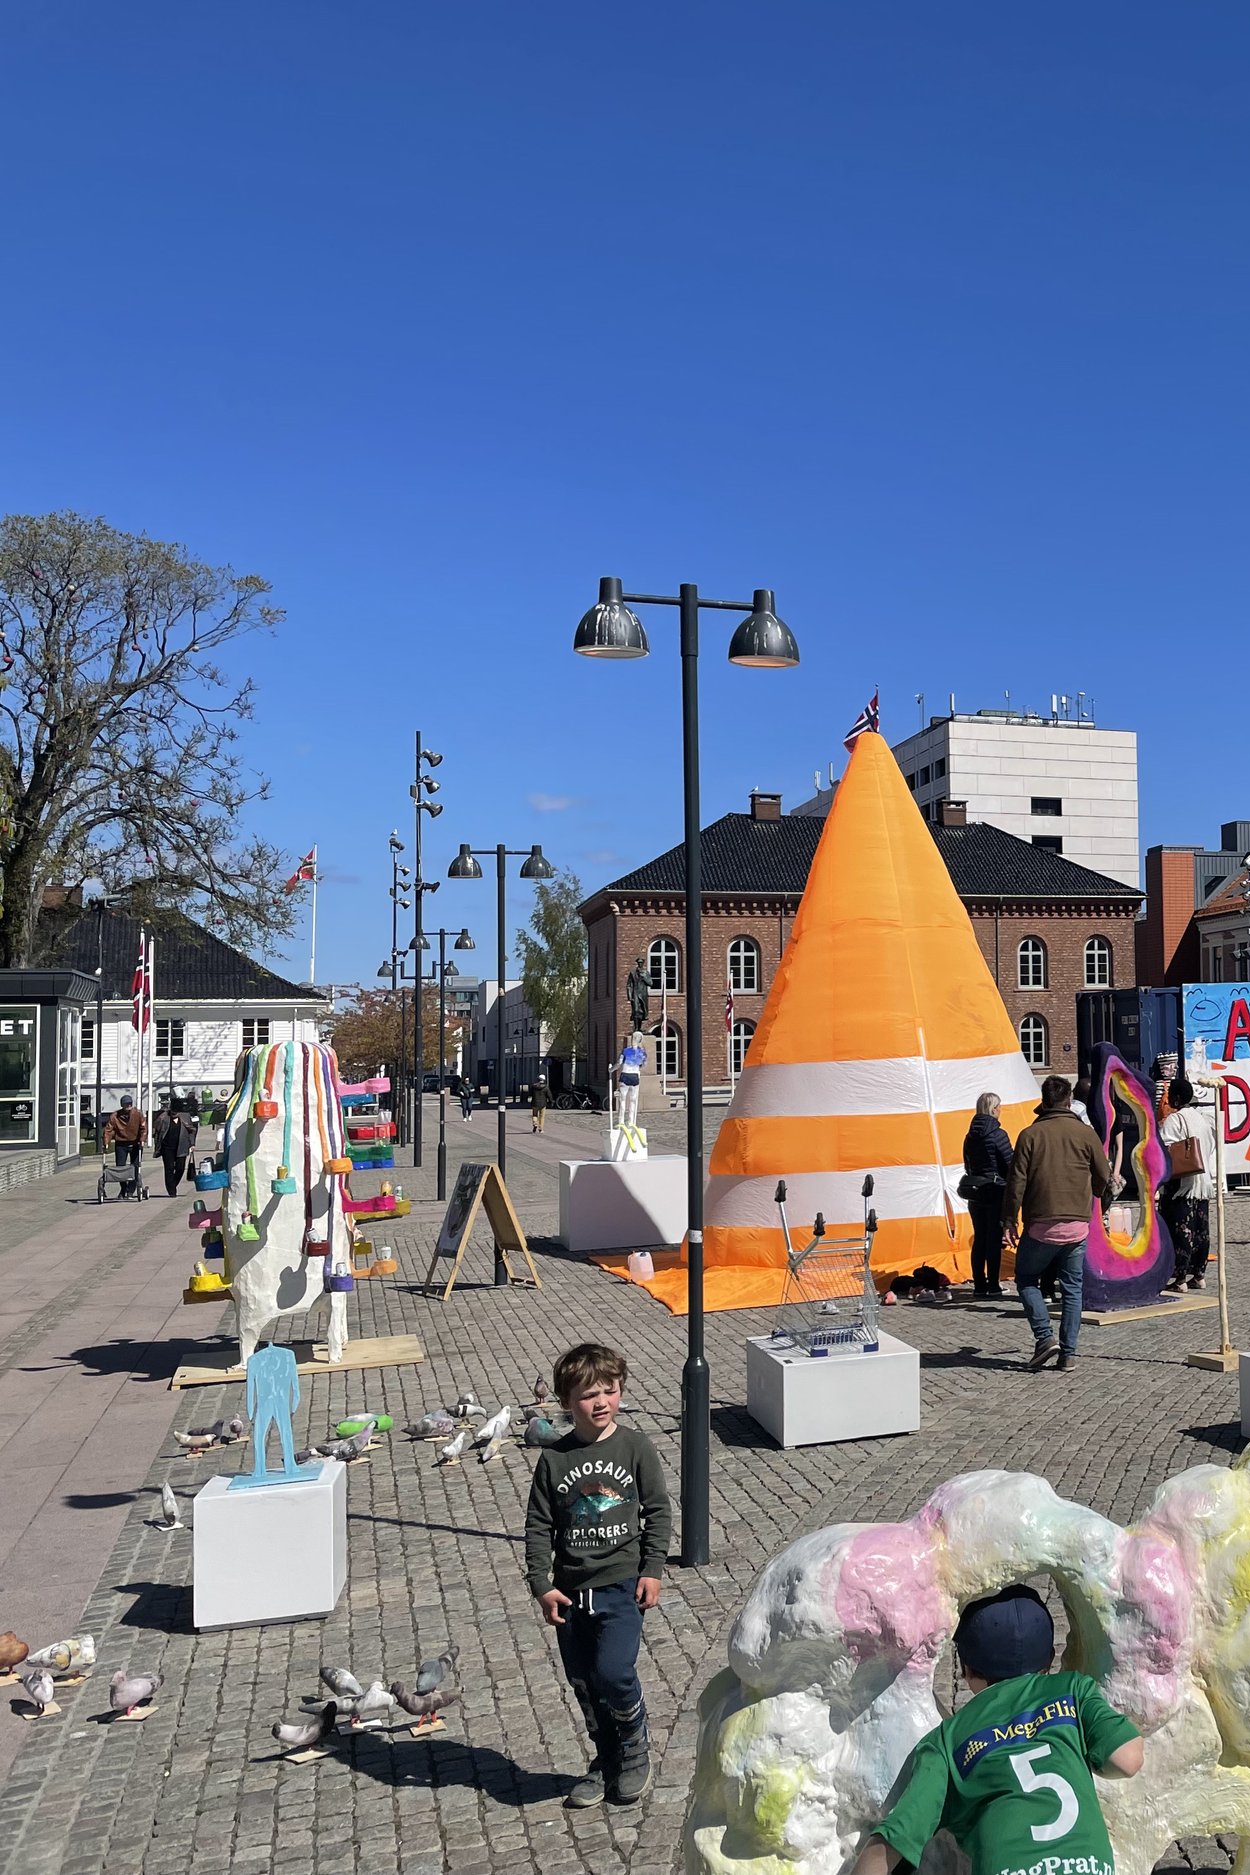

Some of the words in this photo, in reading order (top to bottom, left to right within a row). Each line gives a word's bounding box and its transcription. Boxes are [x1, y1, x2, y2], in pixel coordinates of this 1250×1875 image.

[557, 1460, 634, 1495] DINOSAUR
[991, 1699, 1077, 1742] MegaFlis
[1008, 1743, 1080, 1842] 5
